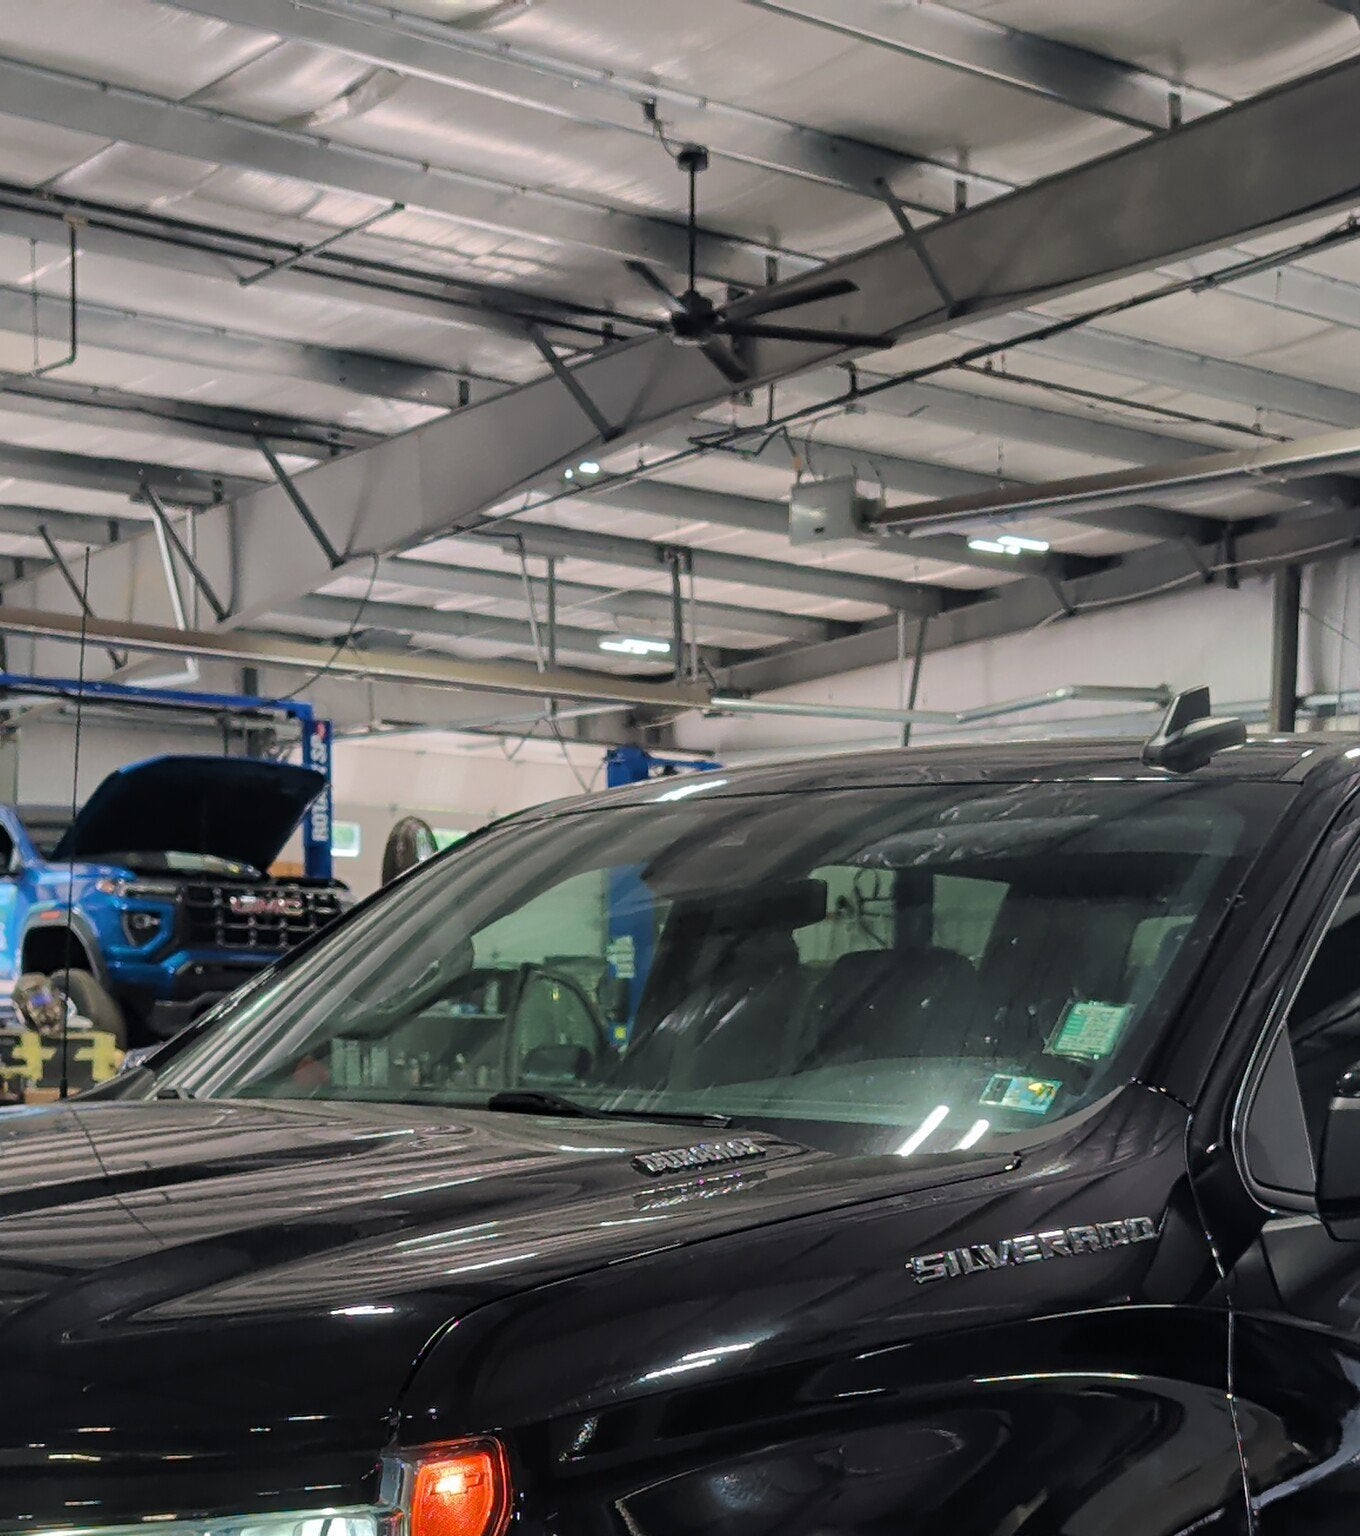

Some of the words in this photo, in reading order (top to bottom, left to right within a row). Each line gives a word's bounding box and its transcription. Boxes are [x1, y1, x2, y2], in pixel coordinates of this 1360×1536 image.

[229, 895, 304, 917] GMC
[633, 1137, 767, 1175] DURAMAX
[904, 1215, 1159, 1285] SILVERADO
